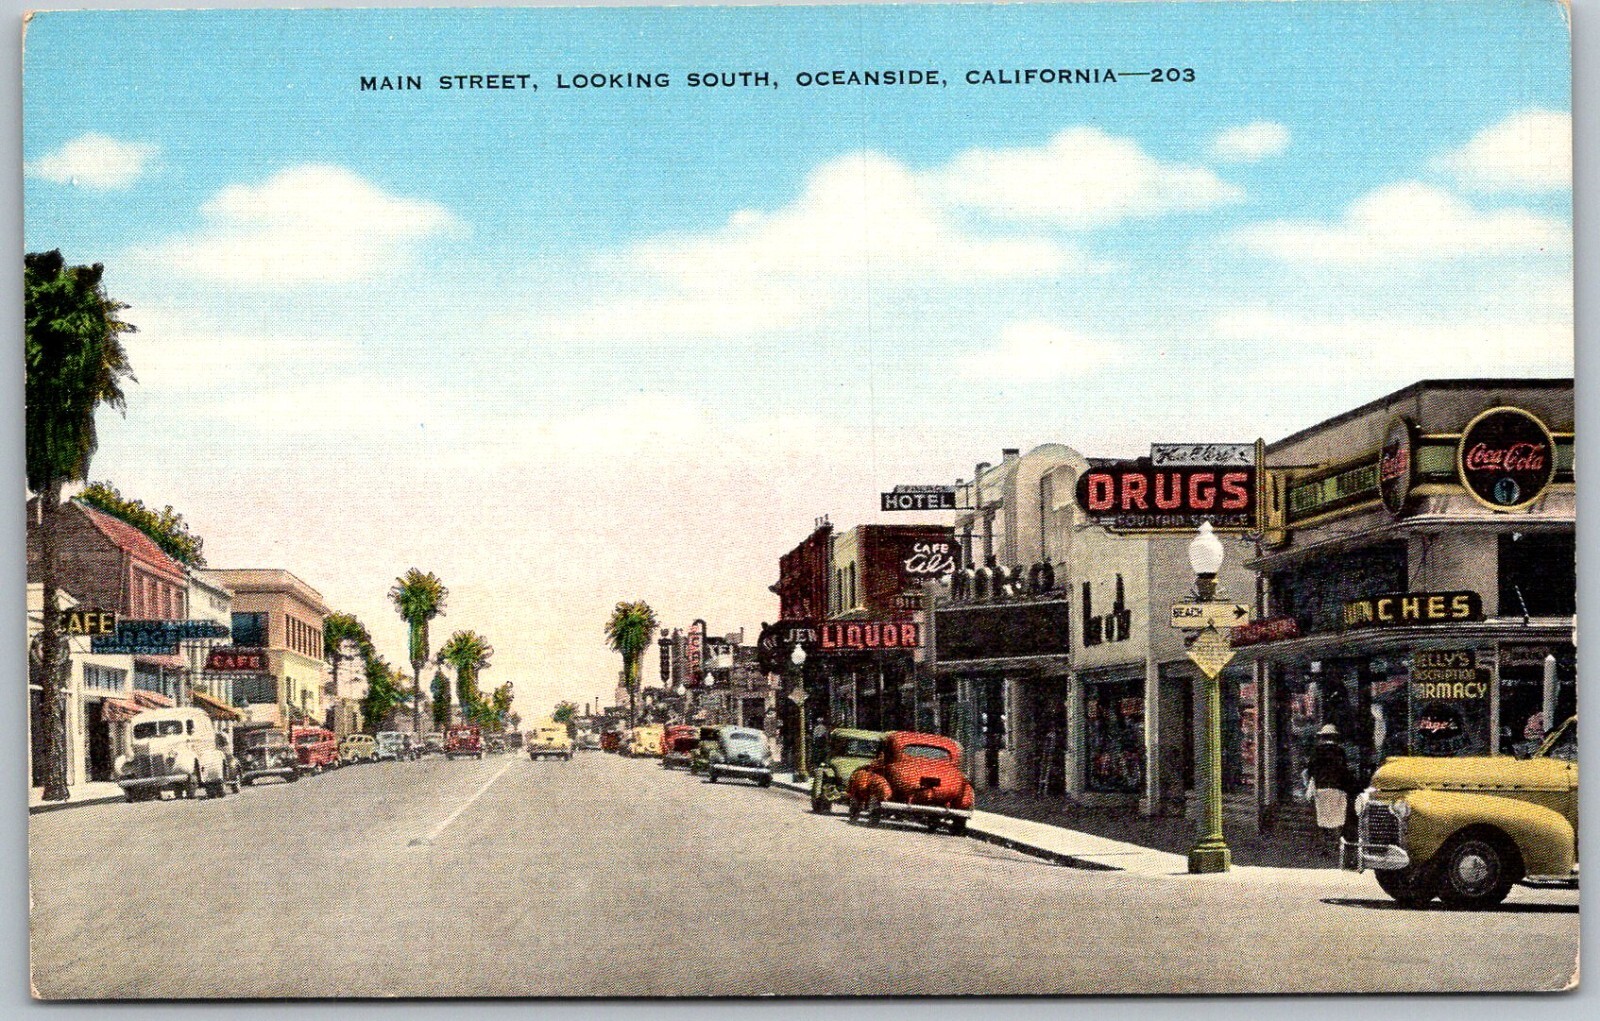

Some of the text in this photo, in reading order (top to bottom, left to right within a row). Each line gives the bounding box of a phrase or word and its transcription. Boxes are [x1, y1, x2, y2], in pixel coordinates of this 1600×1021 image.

[1088, 472, 1249, 510] DRUGS
[885, 494, 952, 508] HOTEL
[913, 543, 949, 553] CAFE
[1172, 607, 1203, 617] BEACH
[822, 624, 917, 648] LIQUOR
[213, 655, 260, 668] CAFE
